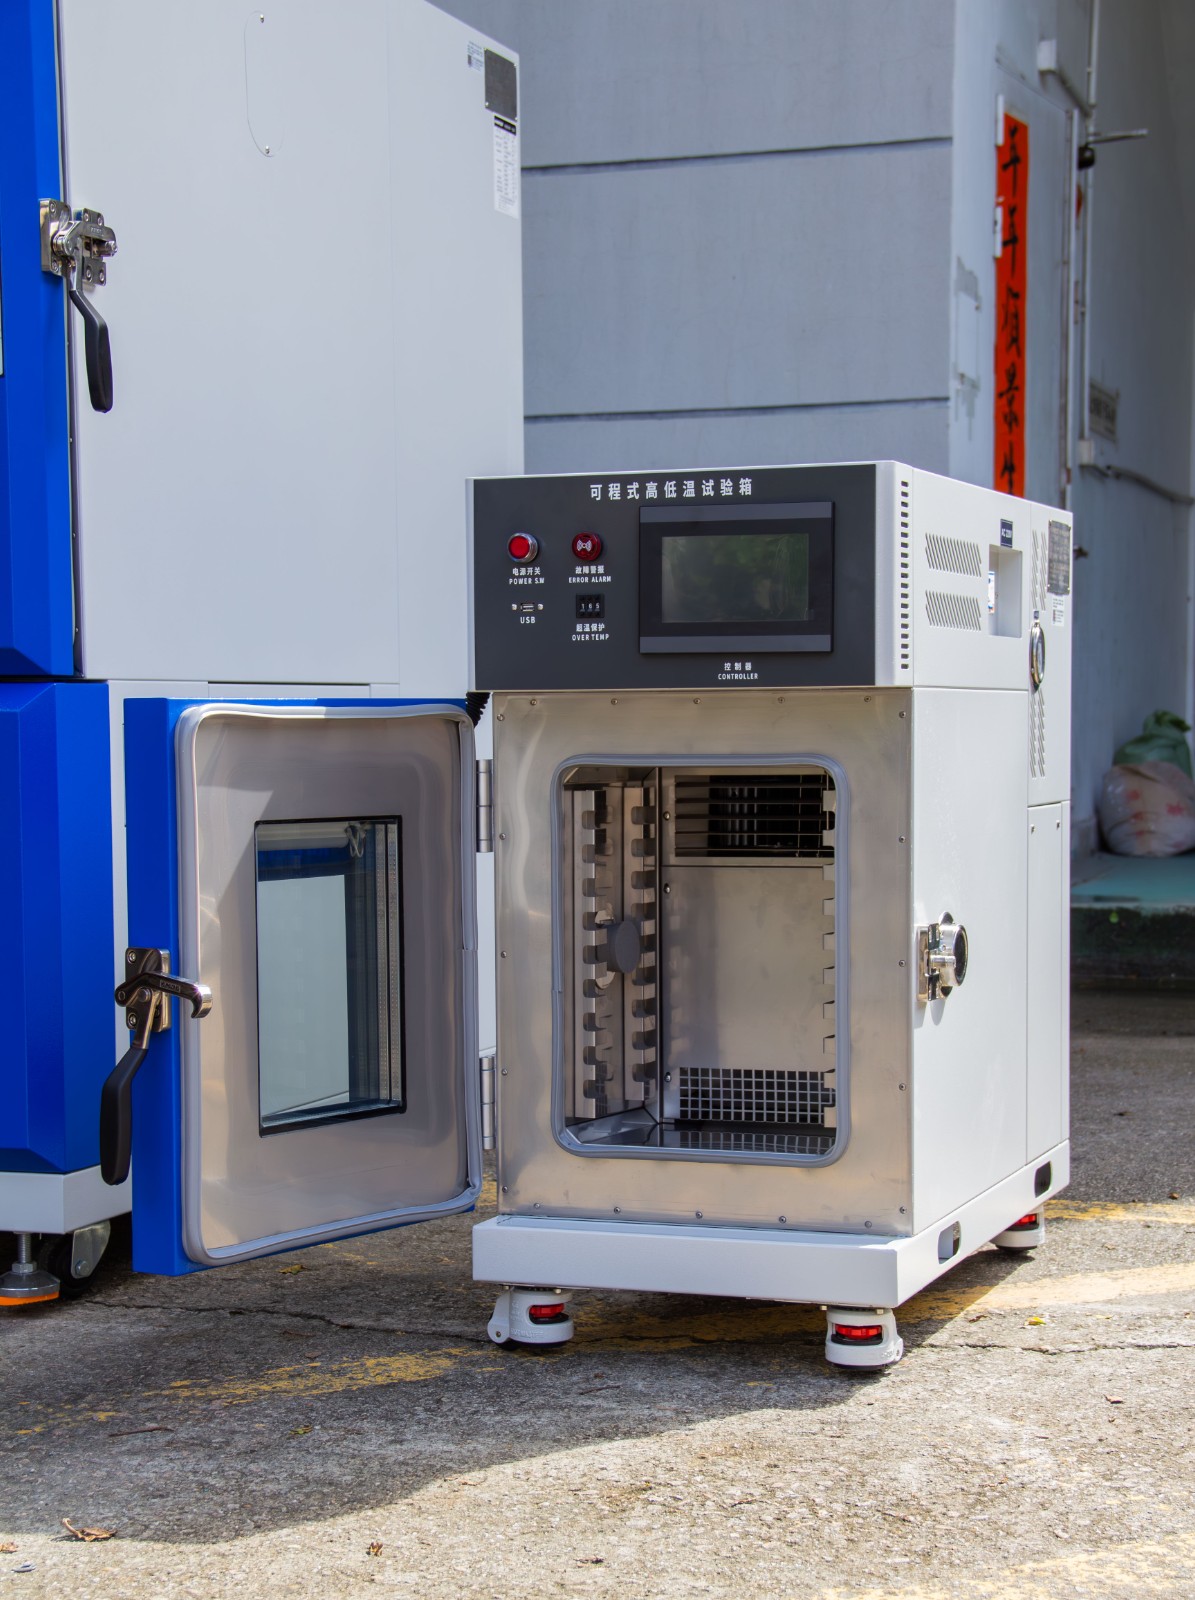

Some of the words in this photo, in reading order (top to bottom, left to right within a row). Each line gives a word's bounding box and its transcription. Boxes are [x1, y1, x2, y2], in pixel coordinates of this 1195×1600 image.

[589, 477, 753, 501] 可程式高低温试验箱
[512, 567, 541, 576] 电源开关
[575, 565, 605, 575] 故障警报
[520, 616, 536, 624] USB
[576, 623, 605, 632] 超温保护
[724, 662, 752, 671] 控制器
